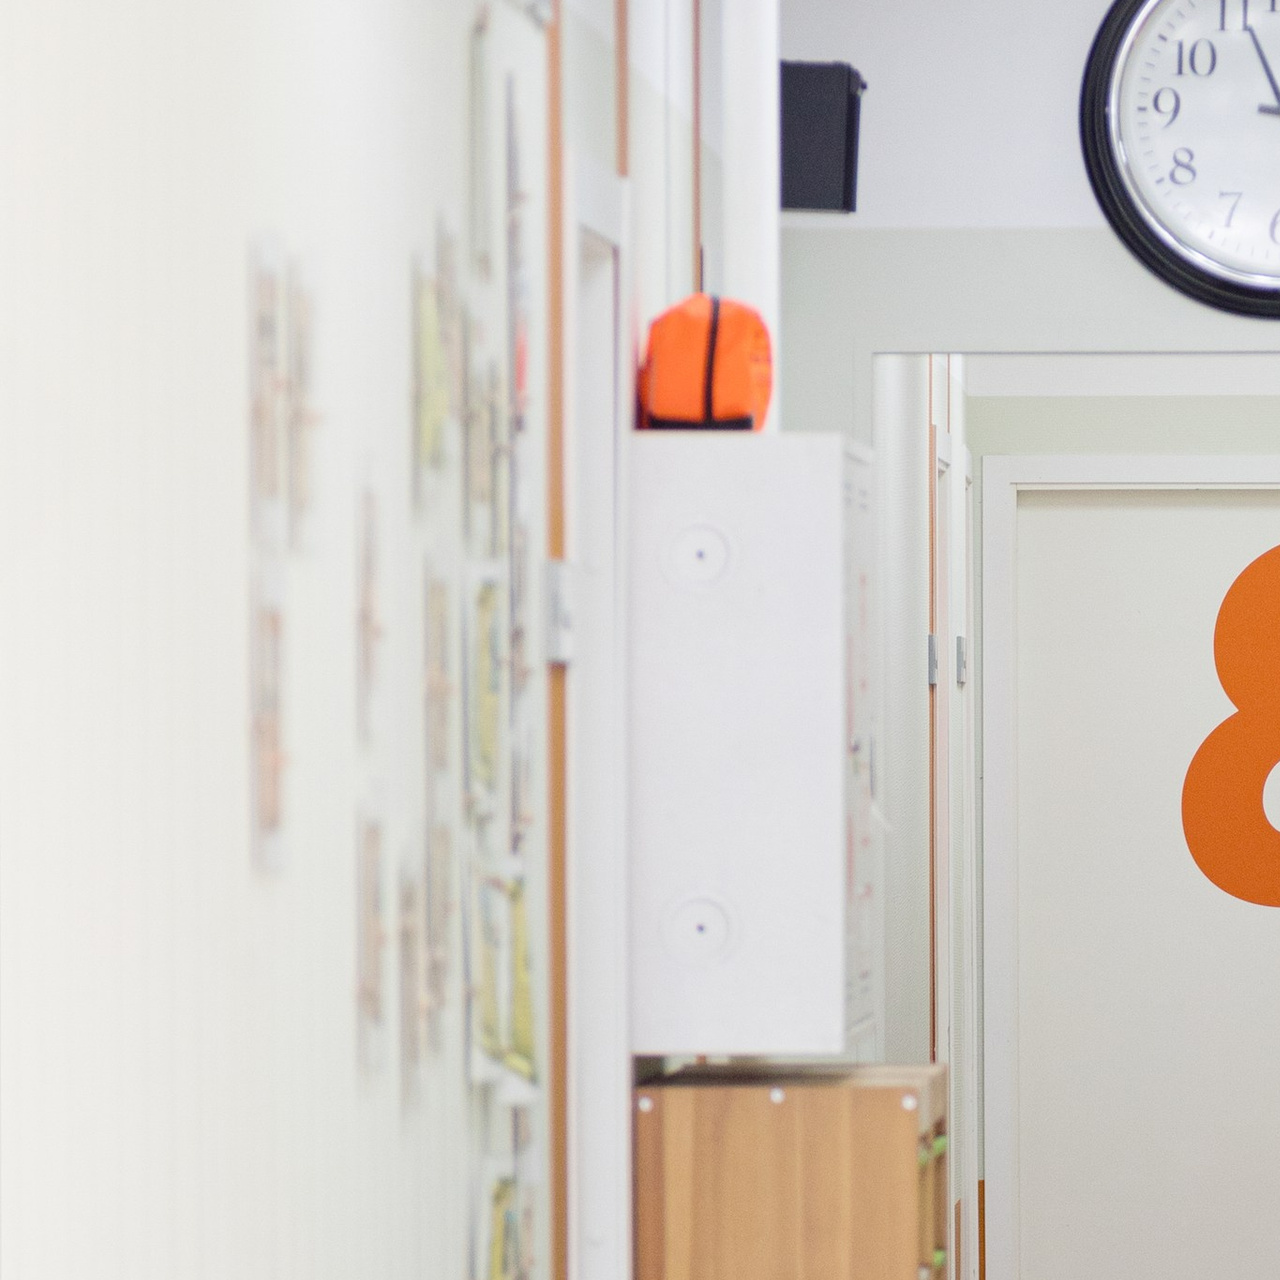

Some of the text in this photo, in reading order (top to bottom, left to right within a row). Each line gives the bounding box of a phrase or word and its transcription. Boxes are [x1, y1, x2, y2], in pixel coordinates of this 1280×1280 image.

[1173, 38, 1217, 77] 10
[1152, 87, 1181, 127] 9
[1169, 147, 1197, 185] 8
[1219, 190, 1243, 228] 7
